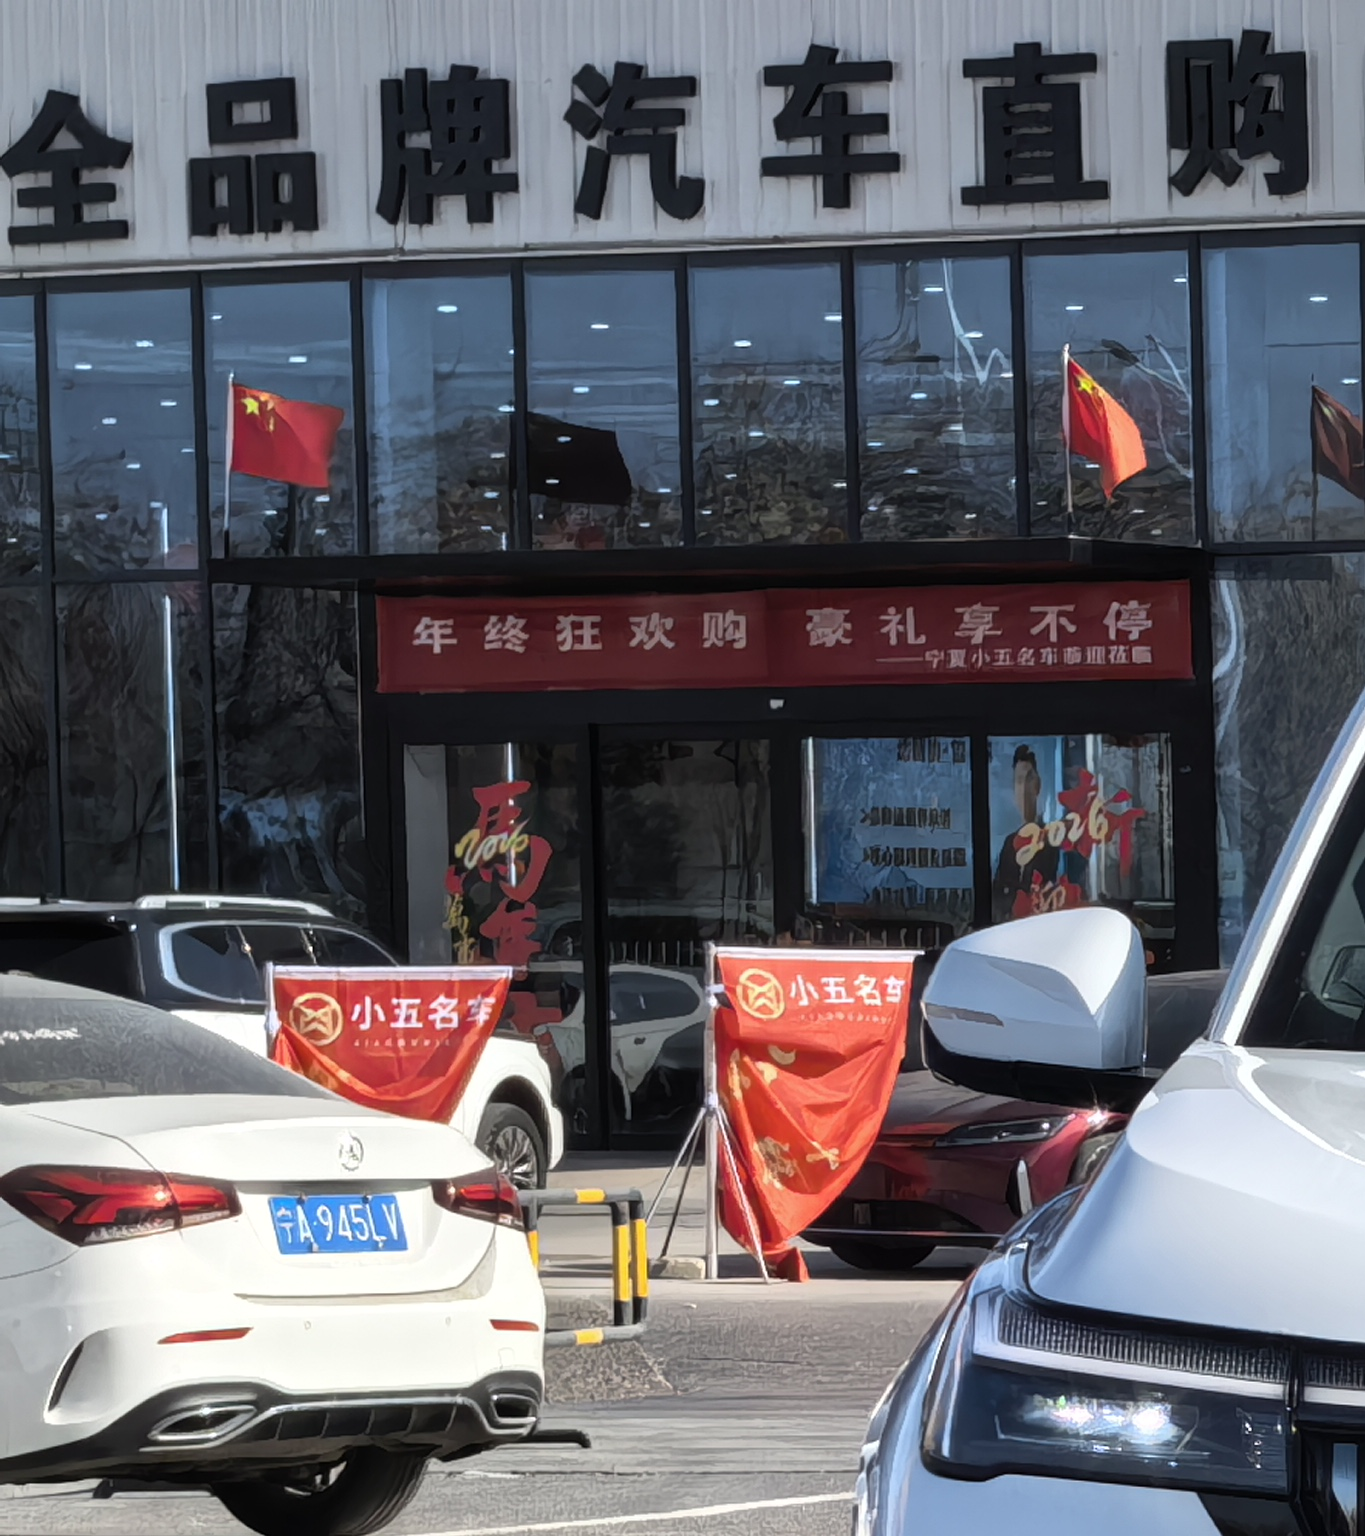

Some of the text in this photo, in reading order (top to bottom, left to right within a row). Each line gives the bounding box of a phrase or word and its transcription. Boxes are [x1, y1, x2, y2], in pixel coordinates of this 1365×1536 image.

[411, 600, 1153, 655] 年终狂欢购 豪礼享不停
[789, 974, 906, 1006] 小五名车
[351, 994, 496, 1031] 小五名车
